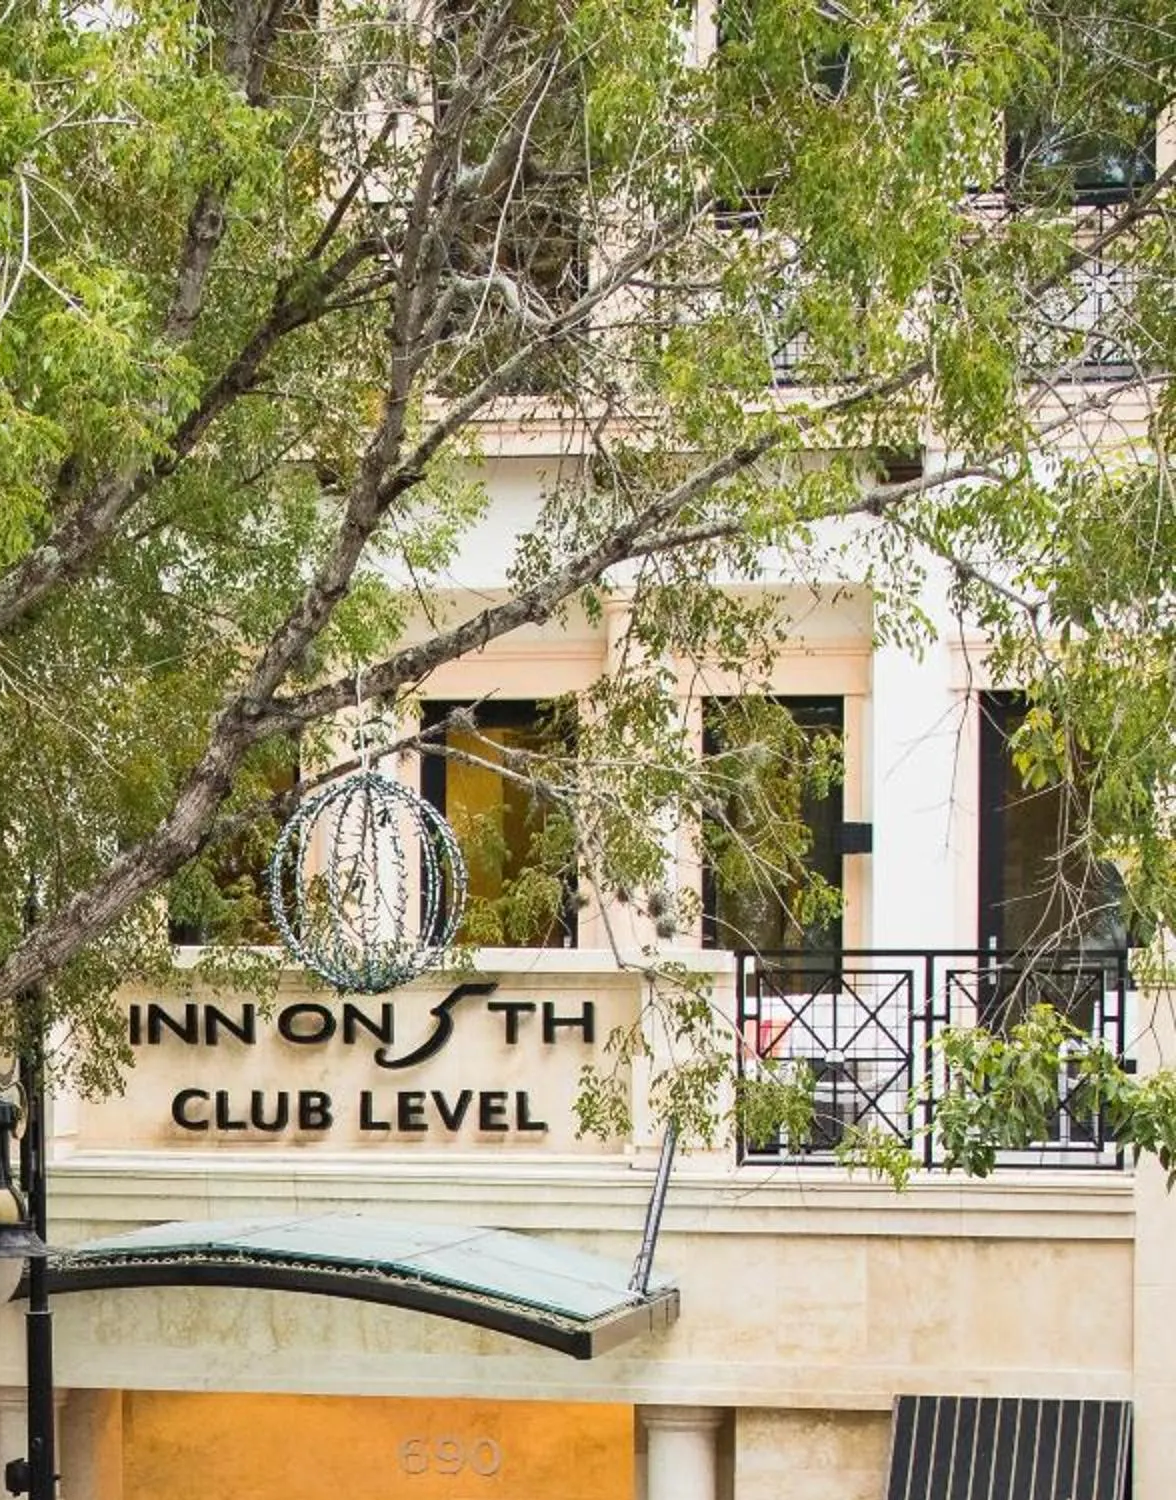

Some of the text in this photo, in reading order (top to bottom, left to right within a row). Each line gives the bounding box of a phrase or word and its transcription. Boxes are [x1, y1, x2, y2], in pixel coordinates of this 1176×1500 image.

[129, 1002, 256, 1046] INN
[277, 1002, 395, 1046] ON
[170, 1088, 549, 1133] CLUB LEVEL
[398, 1436, 504, 1477] 690
